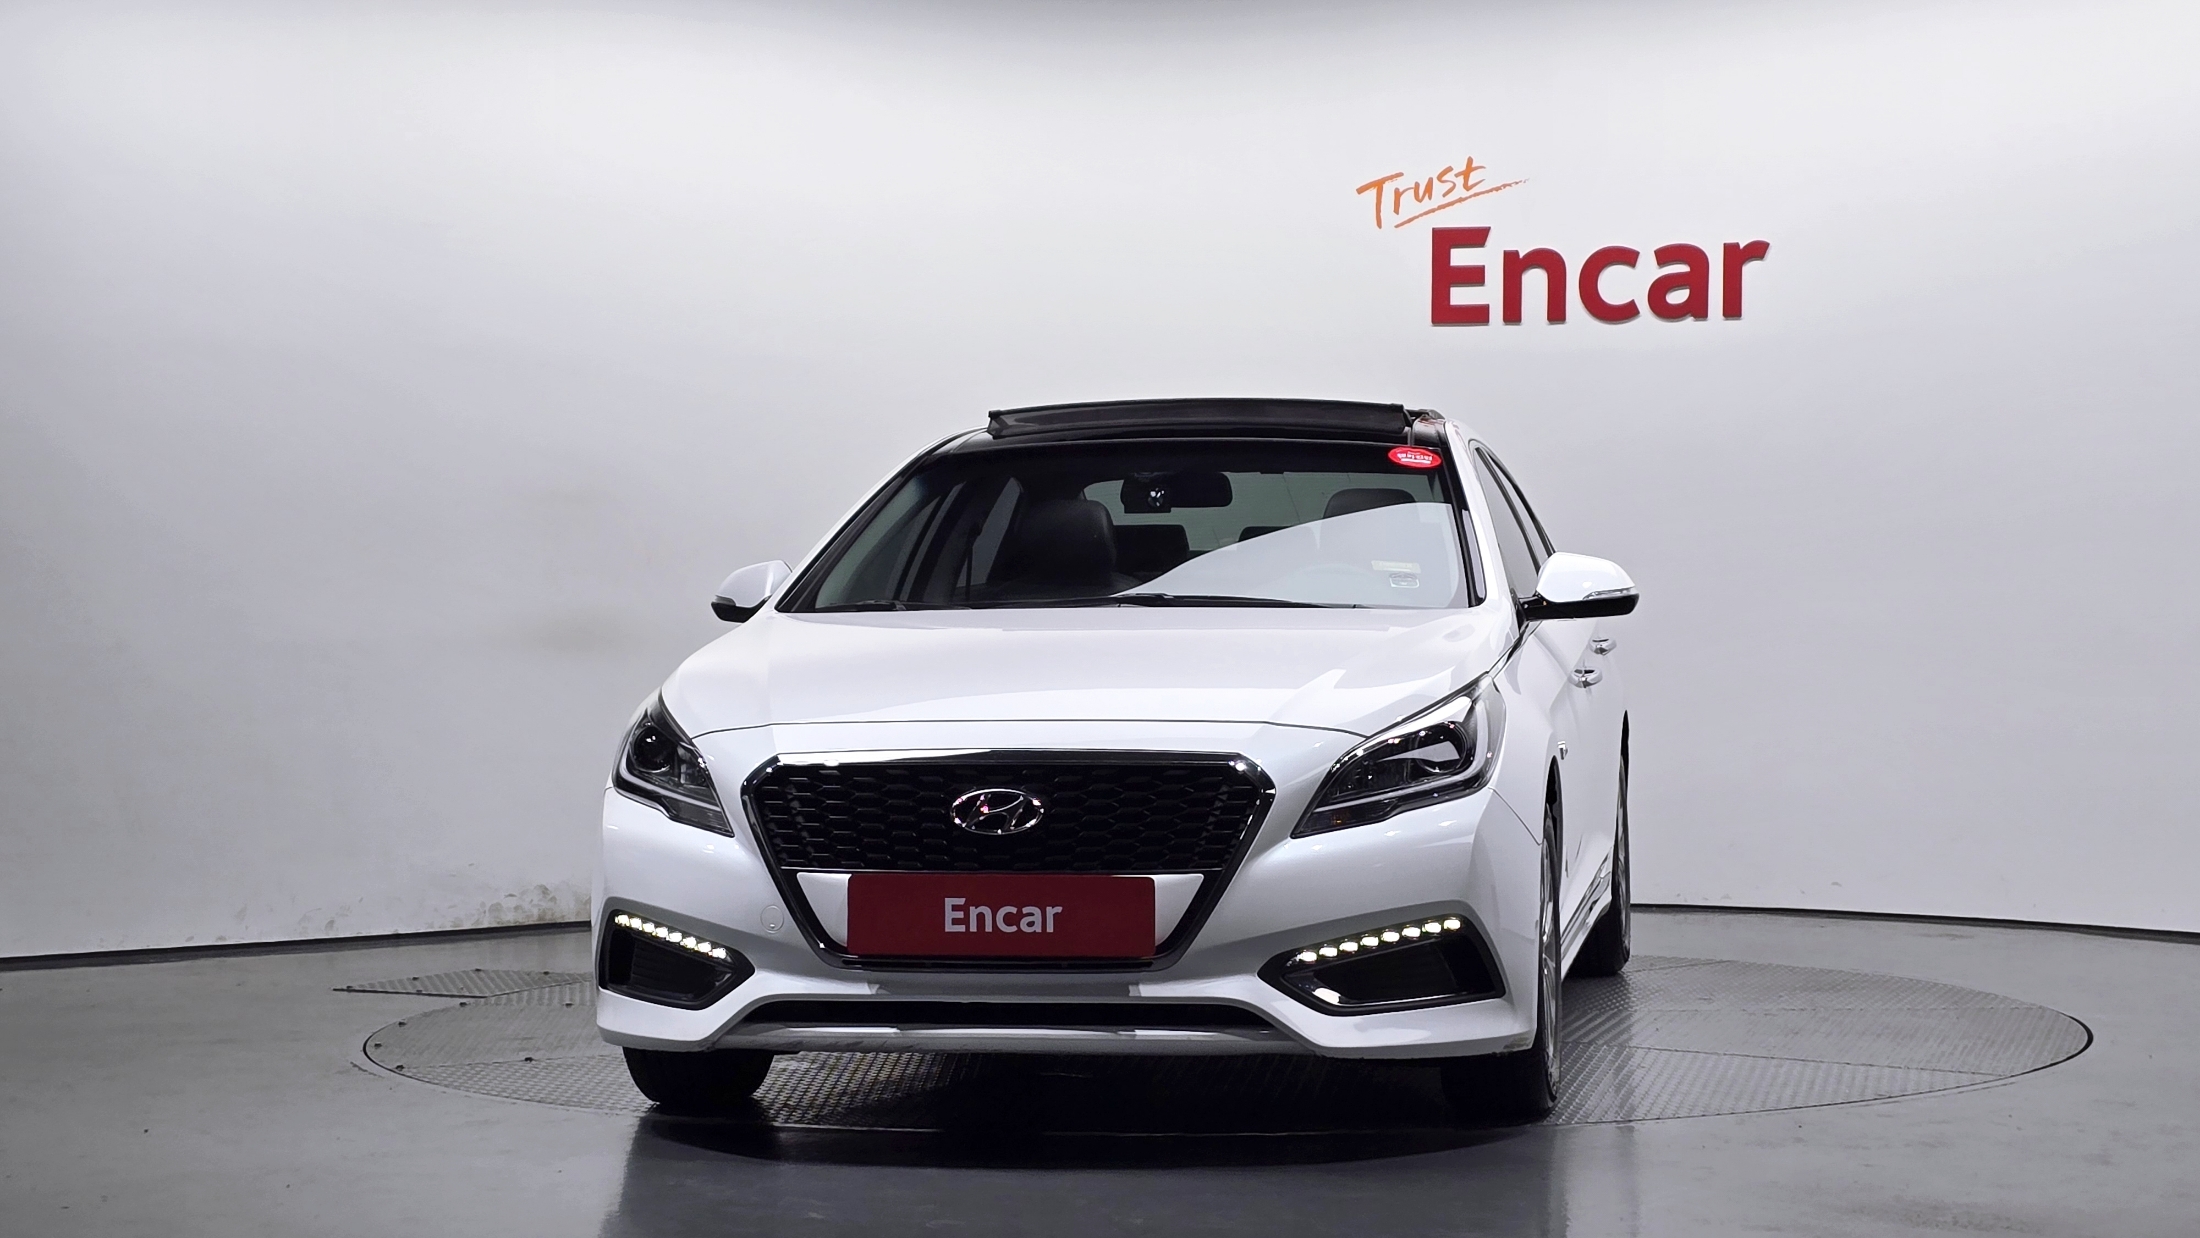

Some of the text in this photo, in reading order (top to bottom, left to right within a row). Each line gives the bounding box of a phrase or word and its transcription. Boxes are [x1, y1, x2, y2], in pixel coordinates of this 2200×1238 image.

[1356, 156, 1487, 229] Trust
[1431, 226, 1770, 326] Encar
[944, 897, 1063, 933] Encar
